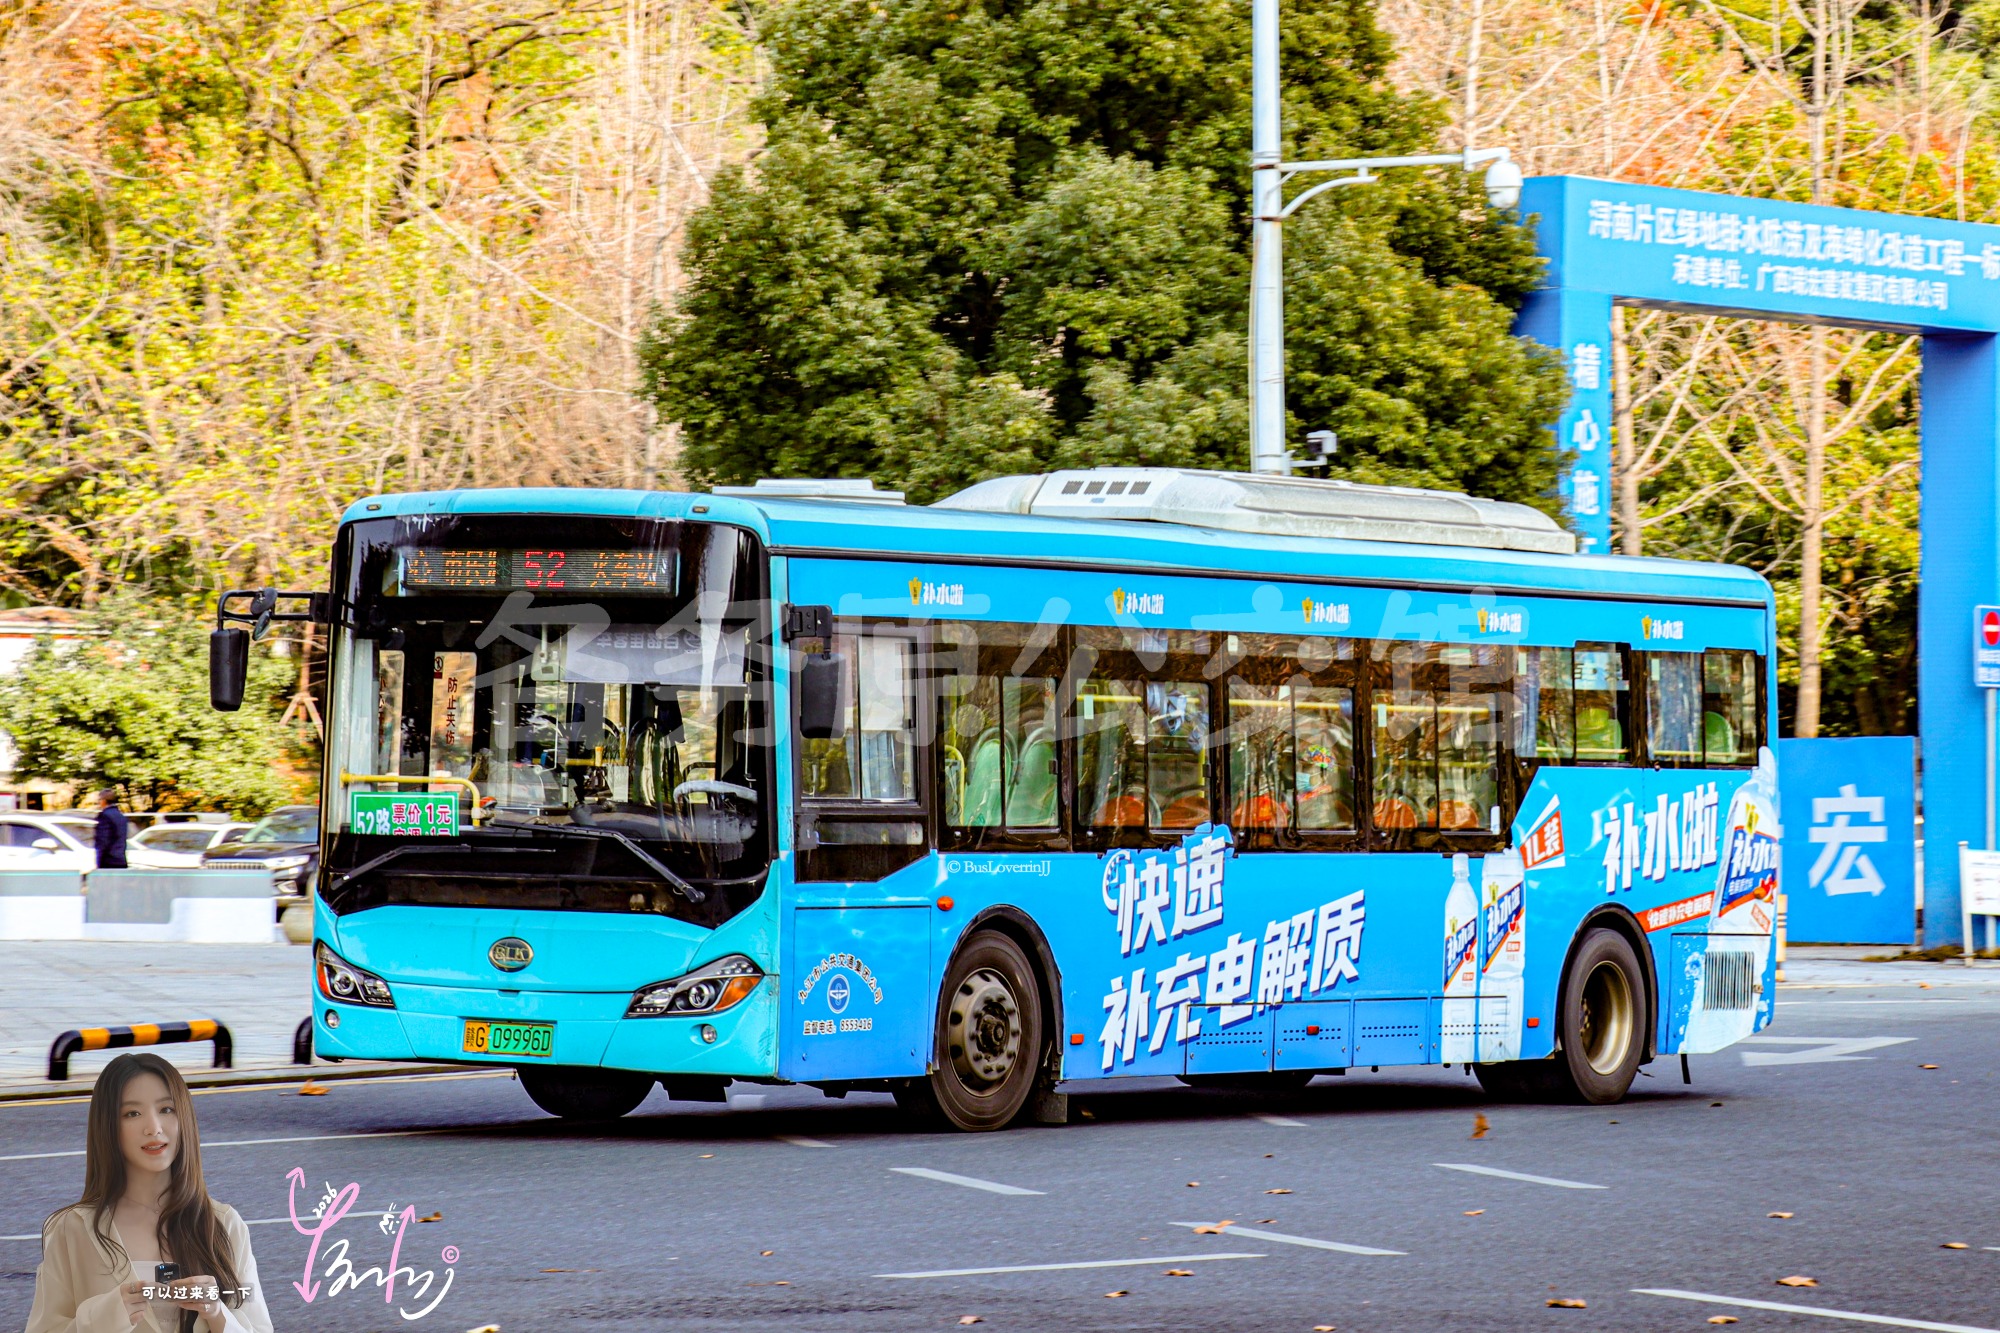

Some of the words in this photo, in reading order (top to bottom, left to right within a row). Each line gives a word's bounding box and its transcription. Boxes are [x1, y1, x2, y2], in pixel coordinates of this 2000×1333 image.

[525, 551, 566, 588] 52
[923, 582, 963, 605] 补水啦
[1126, 593, 1164, 615] 补水啦
[1314, 602, 1350, 624] 补水啦
[1488, 612, 1522, 633] 补水啦
[1652, 619, 1684, 640] 补水啦
[445, 677, 458, 746] 防止夹伤
[1603, 782, 1719, 895] 补水啦
[1808, 784, 1888, 897] 宏
[1102, 836, 1226, 956] 快速
[1099, 889, 1366, 1071] 补充电解质
